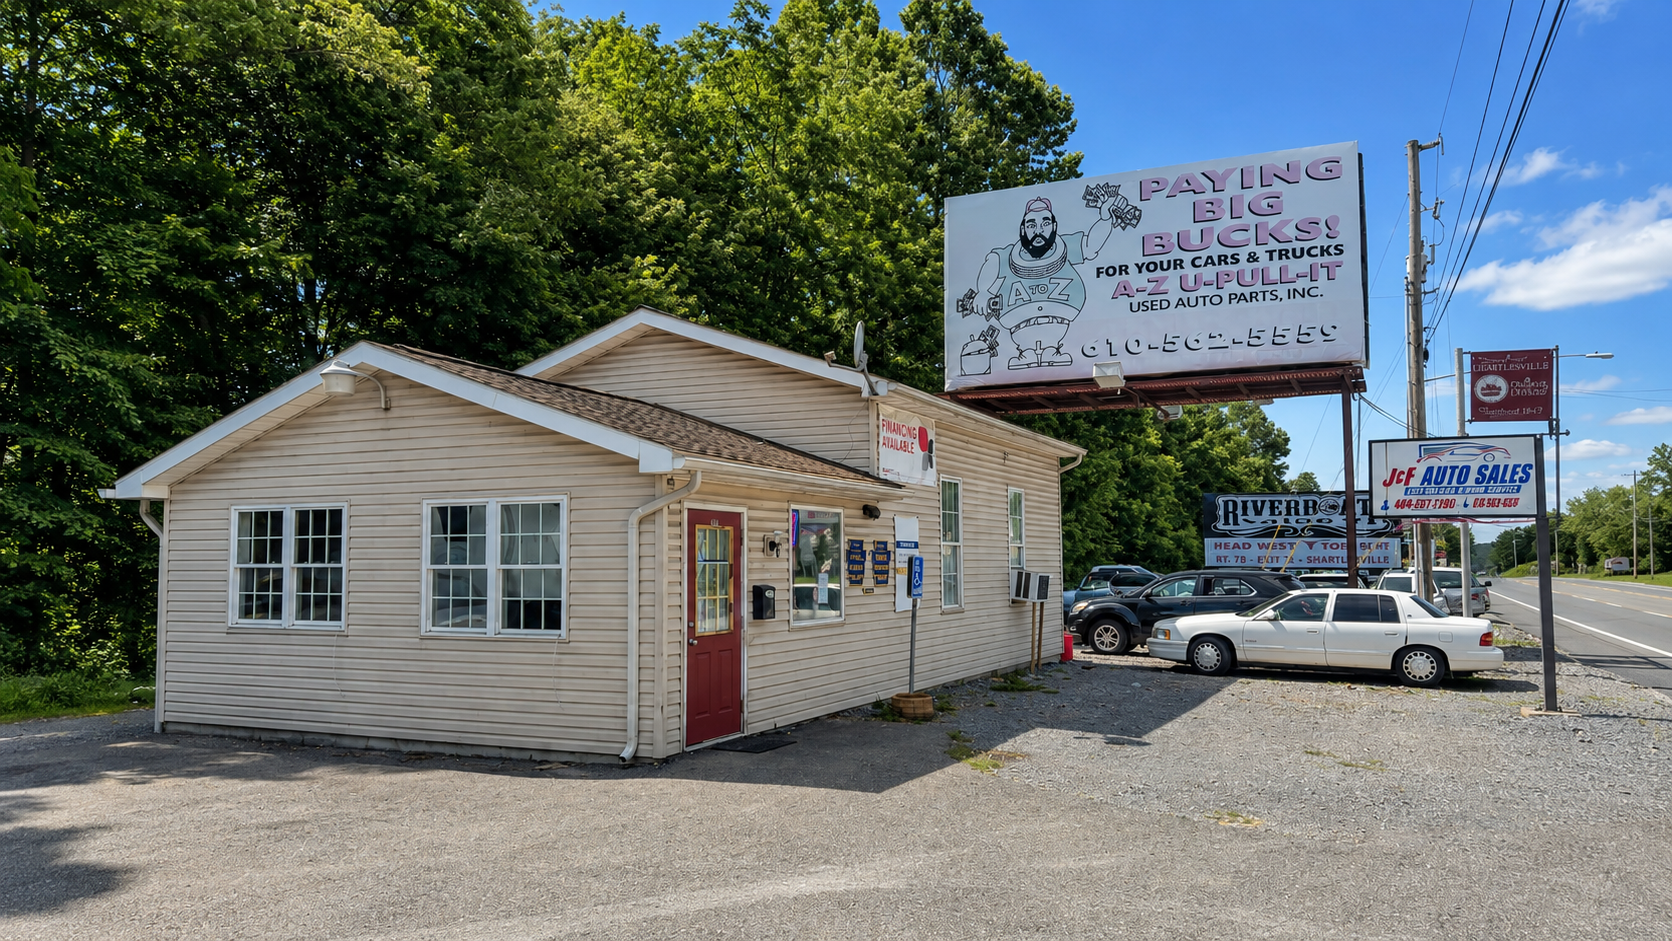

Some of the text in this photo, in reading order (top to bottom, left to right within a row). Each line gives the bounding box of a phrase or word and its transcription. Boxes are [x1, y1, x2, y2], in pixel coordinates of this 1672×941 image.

[1139, 156, 1343, 202] PAYING
[1193, 190, 1284, 223] BIG
[1142, 214, 1341, 257] BUCKS!
[1096, 243, 1345, 278] FOR YOUR CARS & TRUCKS
[1007, 277, 1074, 307] A TO Z
[1111, 260, 1344, 299] A-Z U-PULL-IT
[1129, 286, 1324, 313] USED AUTO PARTS, INC.
[882, 436, 915, 455] AVAILABLE
[1420, 465, 1471, 486] AUTO
[1474, 463, 1533, 485] SALES
[1214, 542, 1252, 550] HEAD
[1257, 542, 1297, 550] WEST
[1216, 555, 1231, 563] RT.
[1306, 555, 1390, 564] SHARTLVILLE
